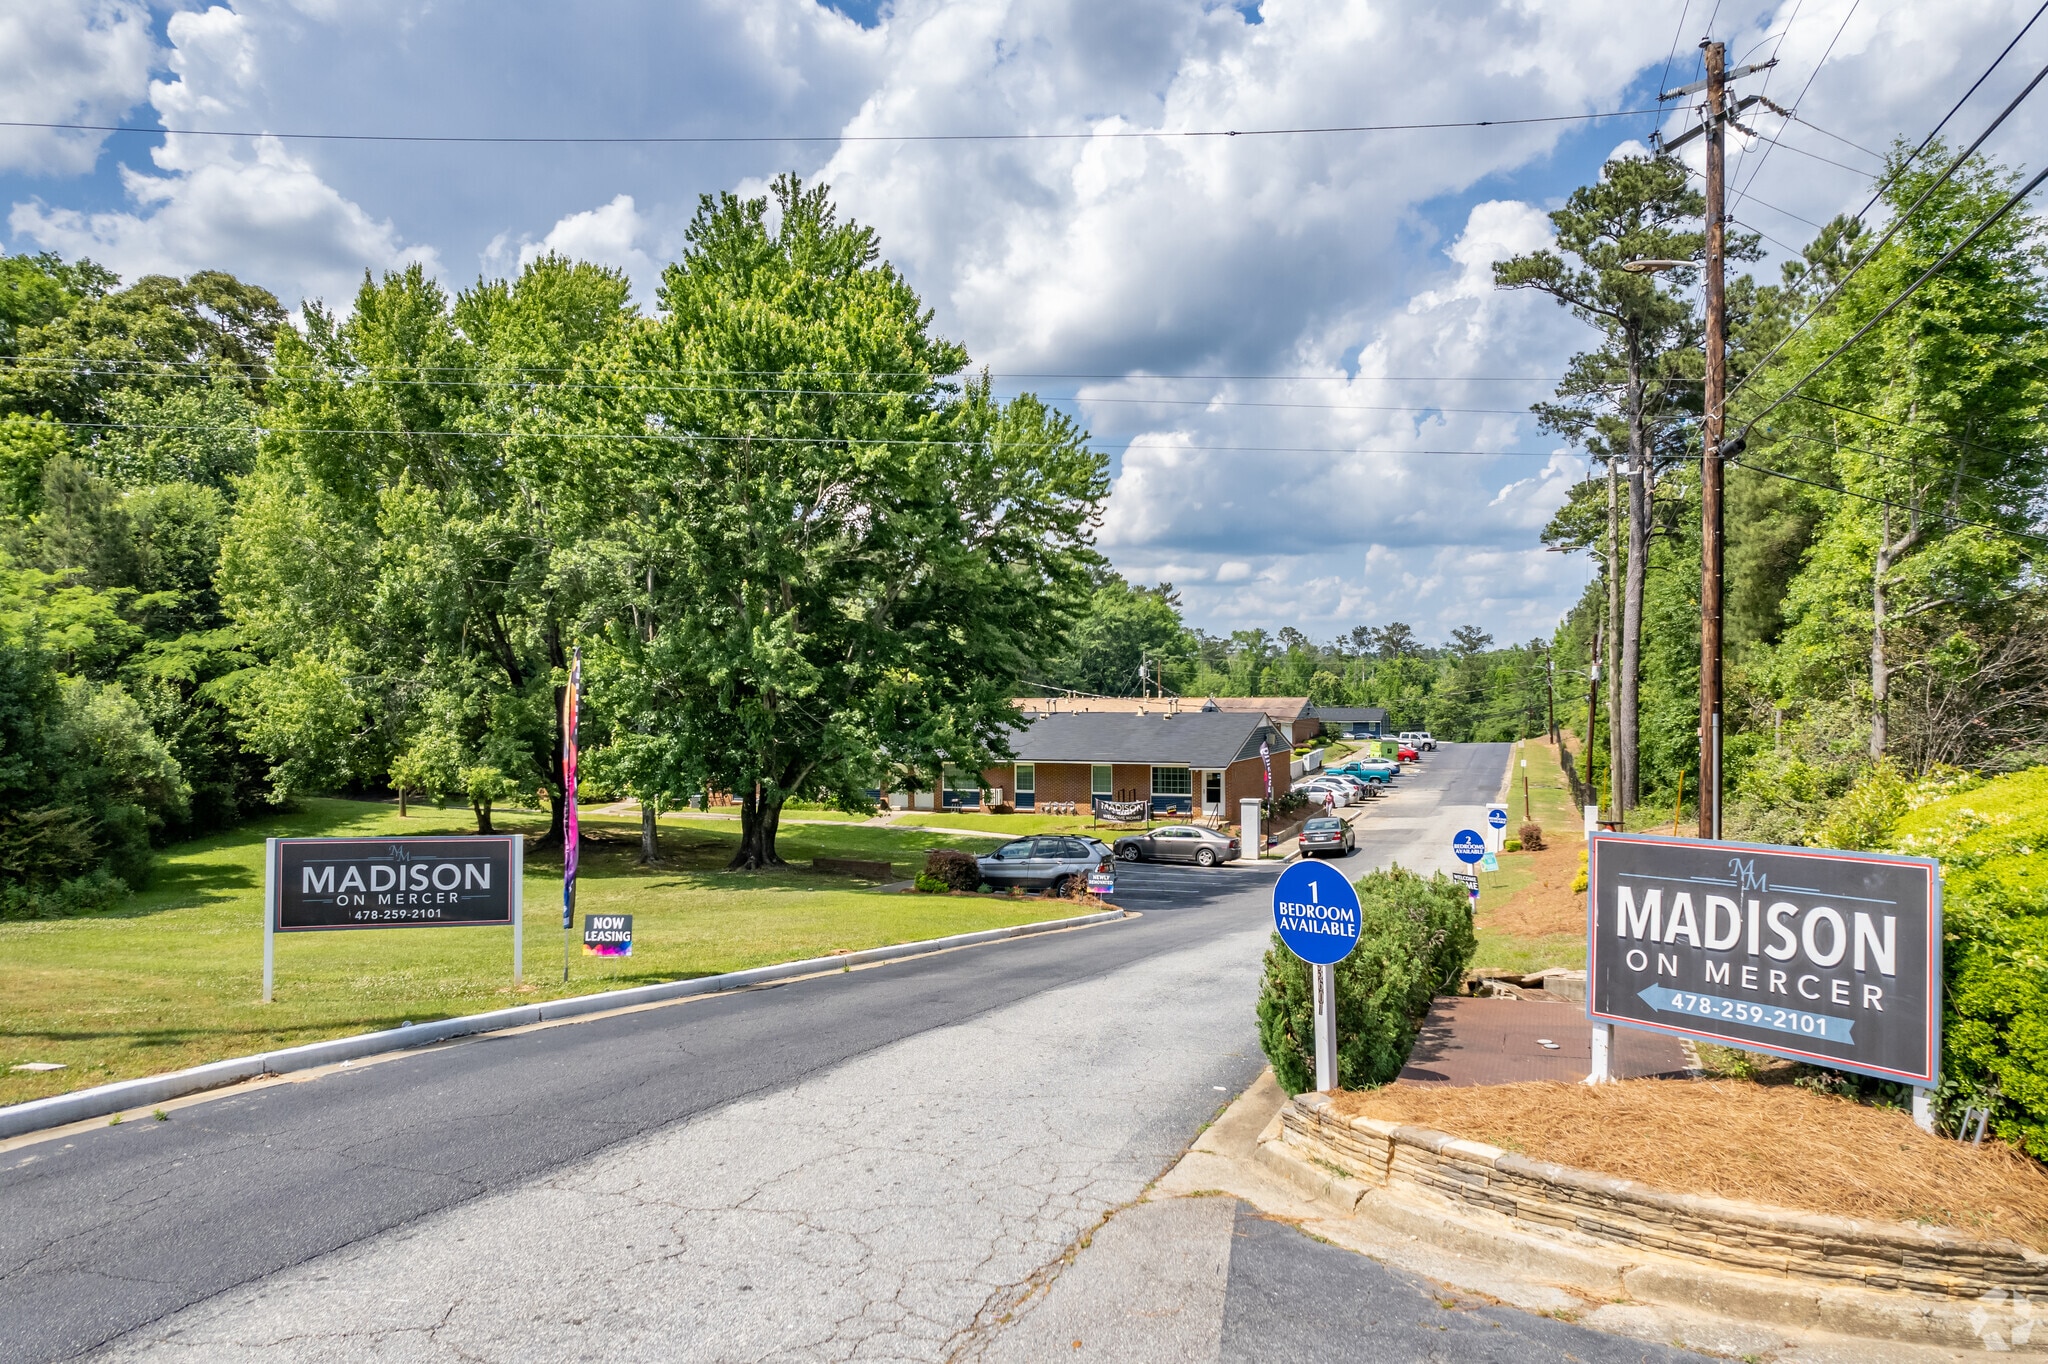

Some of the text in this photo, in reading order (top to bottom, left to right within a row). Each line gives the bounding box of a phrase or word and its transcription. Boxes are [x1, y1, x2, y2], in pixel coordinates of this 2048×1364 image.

[1100, 802, 1144, 812] MADISON
[1465, 836, 1471, 844] 2
[302, 863, 491, 894] MADISON
[336, 892, 458, 906] ON MERCER
[1308, 880, 1319, 904] 1
[354, 908, 441, 920] 478-259-2101
[1279, 901, 1355, 922] BEDROOM
[593, 916, 625, 930] NOW
[1279, 916, 1356, 938] AVAILABLE
[1616, 885, 1897, 976] MADISON
[585, 931, 631, 942] LEASING
[1626, 949, 1884, 1012] ON MERCER
[1671, 993, 1827, 1036] 478-259-2101
